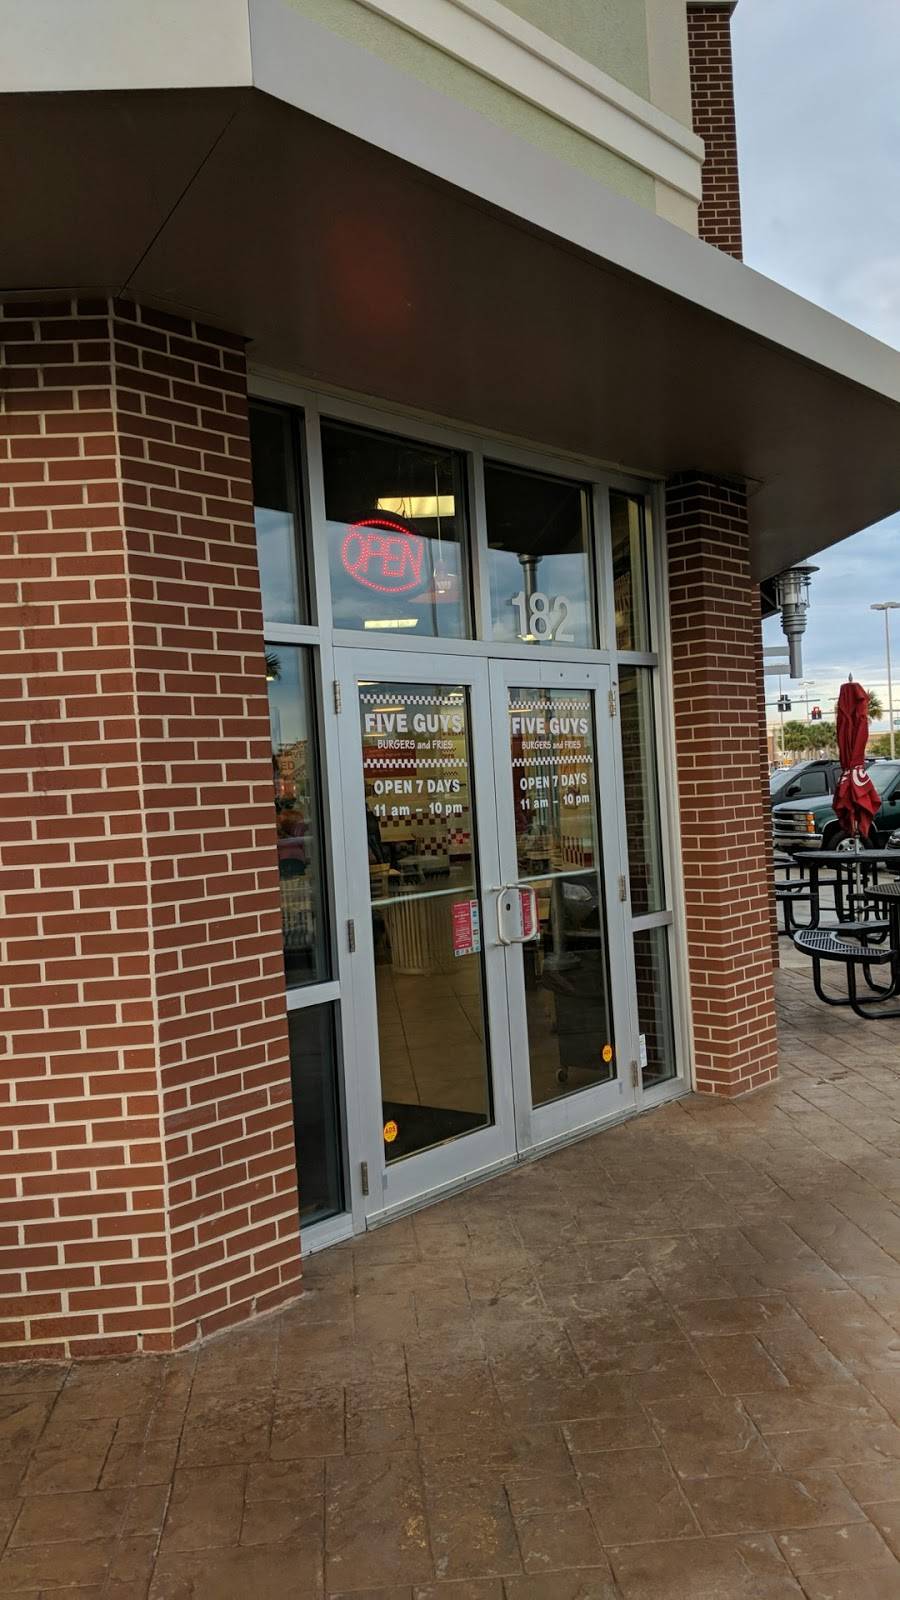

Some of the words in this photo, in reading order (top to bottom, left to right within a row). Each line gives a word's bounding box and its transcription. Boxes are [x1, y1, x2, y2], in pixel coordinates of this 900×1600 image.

[343, 532, 423, 583] OPEN
[511, 591, 575, 642] 182
[364, 713, 409, 733] FIVE
[413, 714, 463, 733] GUYS
[512, 717, 545, 735] FIVE
[549, 717, 589, 735] GUYS
[377, 739, 416, 750] BURGERS
[416, 740, 431, 750] and
[432, 739, 454, 750] FRIES
[521, 740, 552, 750] BURGERS
[552, 740, 564, 750] and
[564, 740, 582, 750] FRIES
[373, 779, 413, 795] OPEN
[416, 780, 424, 794] 7
[427, 779, 461, 793] DAYS
[519, 776, 550, 791] OPEN
[552, 775, 559, 788] 7
[561, 773, 588, 787] DAYS
[373, 804, 386, 817] 11
[391, 805, 410, 817] am
[428, 802, 442, 815] 10
[445, 803, 463, 817] pm
[520, 798, 530, 811] 11
[533, 798, 549, 810] am
[563, 793, 574, 806] 10
[575, 793, 590, 807] pm
